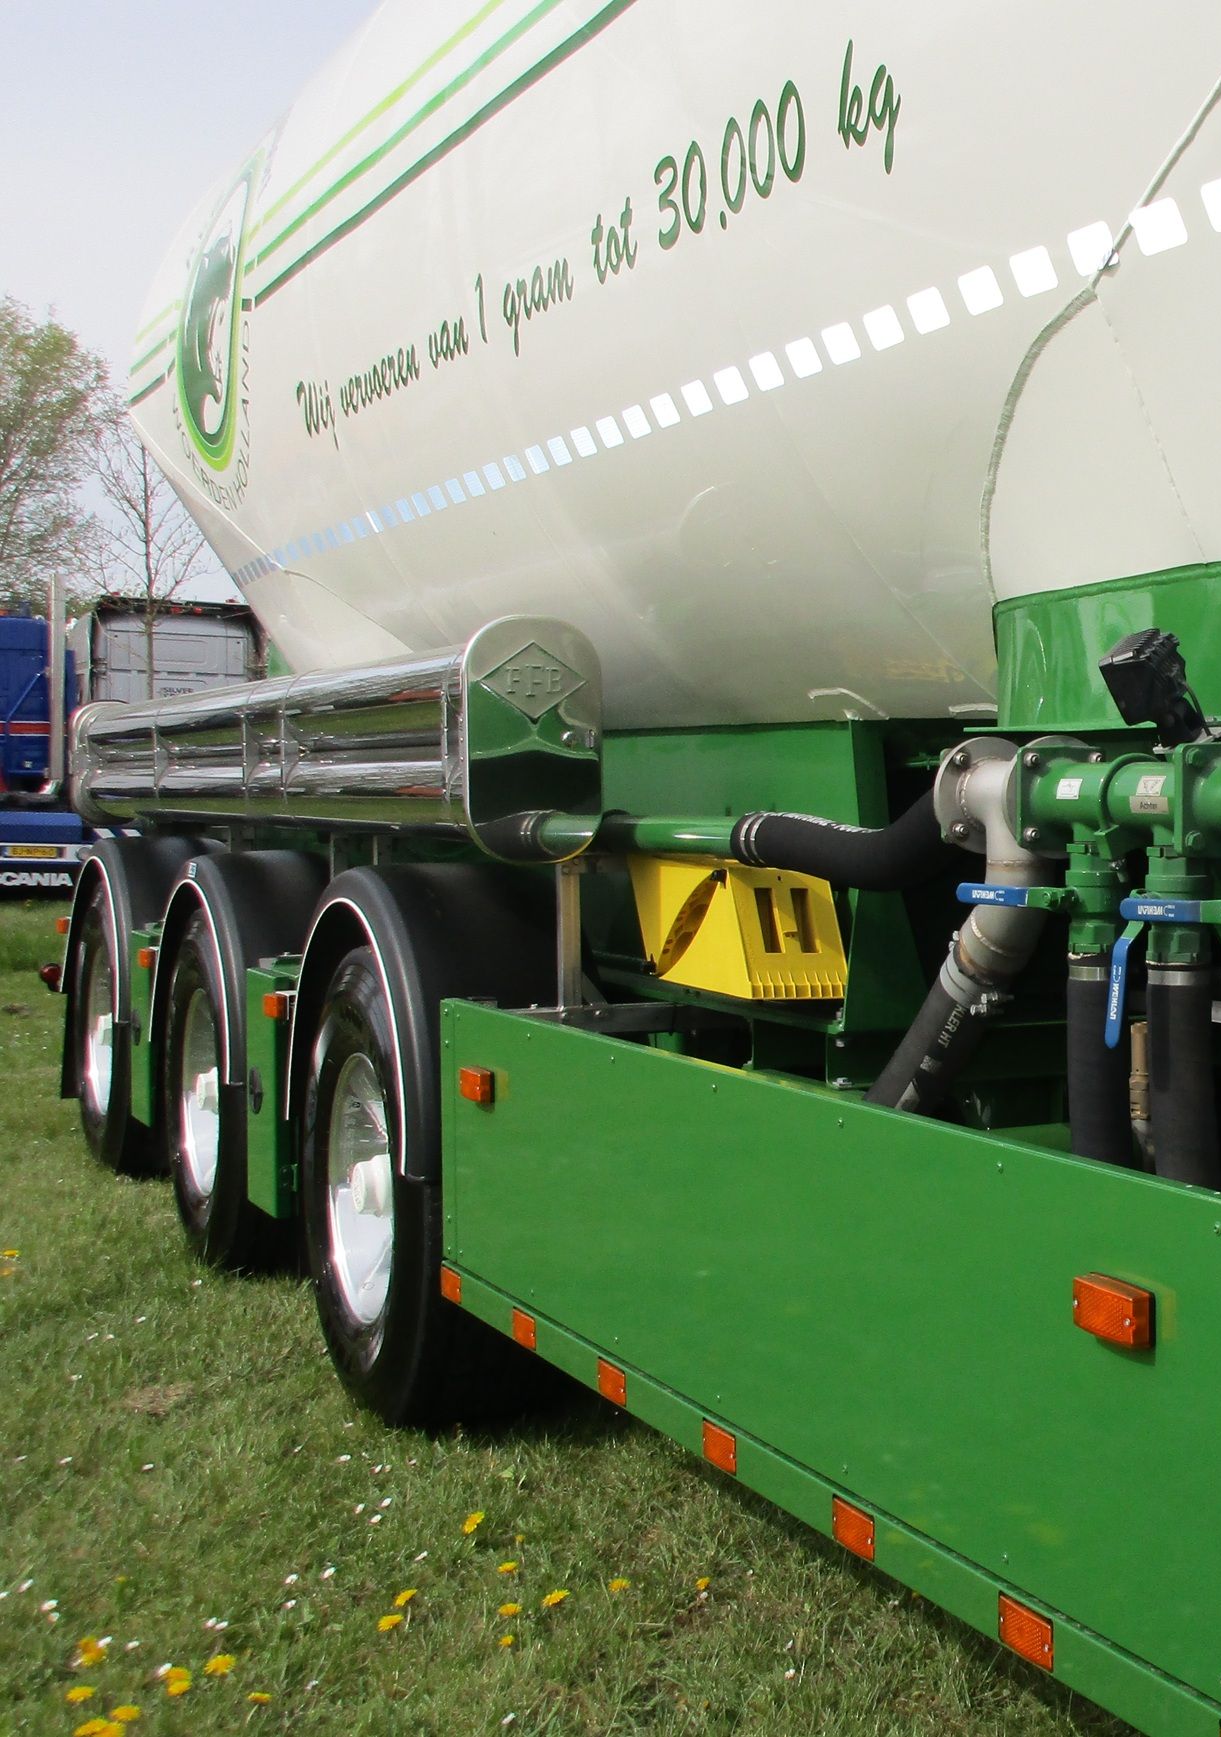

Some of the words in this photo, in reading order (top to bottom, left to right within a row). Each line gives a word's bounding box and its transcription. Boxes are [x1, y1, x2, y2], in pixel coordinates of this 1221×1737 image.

[296, 380, 339, 451] Wij
[340, 343, 420, 418] vervoeren
[428, 315, 469, 369] van
[474, 272, 488, 344] 1
[502, 257, 574, 358] gram
[591, 196, 638, 285] tot
[653, 79, 806, 251] 30.000
[836, 38, 901, 175] kg
[233, 319, 251, 505] HOLLAND
[0, 871, 74, 886] CANIA
